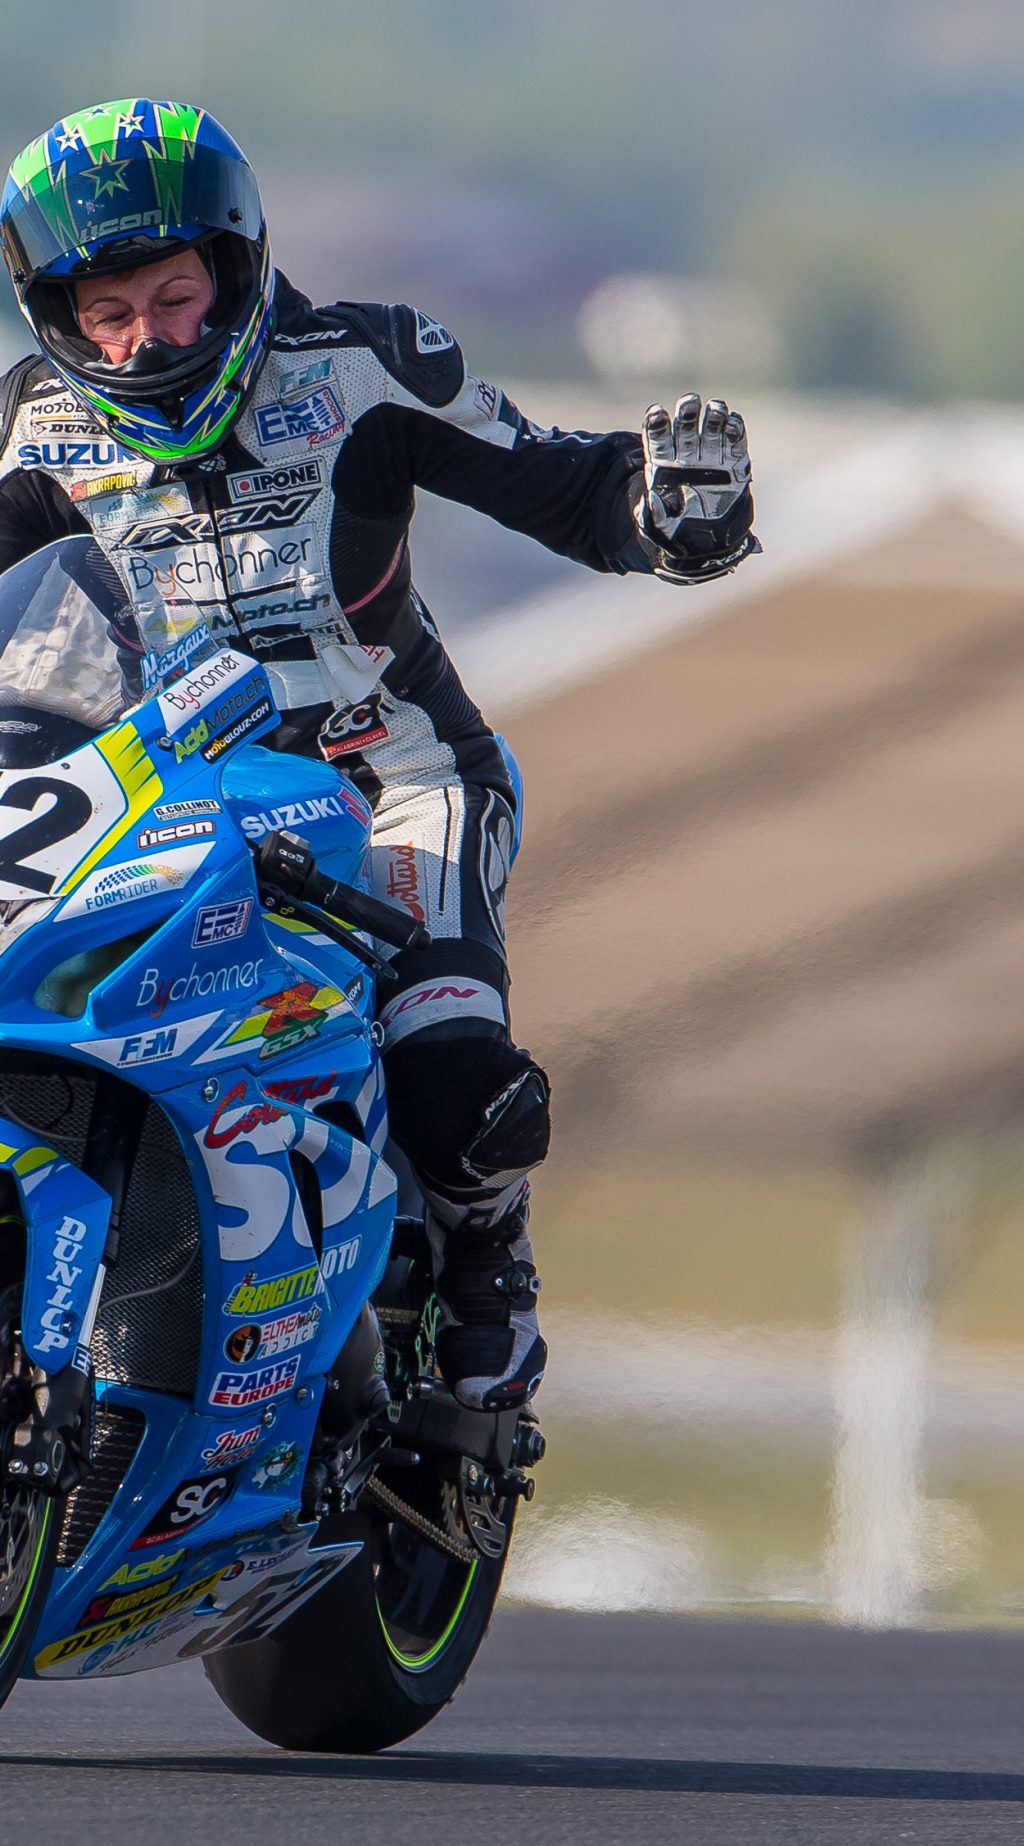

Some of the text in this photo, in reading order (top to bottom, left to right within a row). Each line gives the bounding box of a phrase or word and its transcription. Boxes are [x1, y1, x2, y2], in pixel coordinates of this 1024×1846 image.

[253, 463, 318, 493] IPONE
[164, 653, 241, 711] Bychonner
[240, 797, 345, 839] SUZUKI
[86, 879, 158, 910] FORMRIDER
[136, 958, 264, 1018] Bychonner
[212, 1376, 295, 1406] EUROPE
[218, 1357, 298, 1393] PARTS
